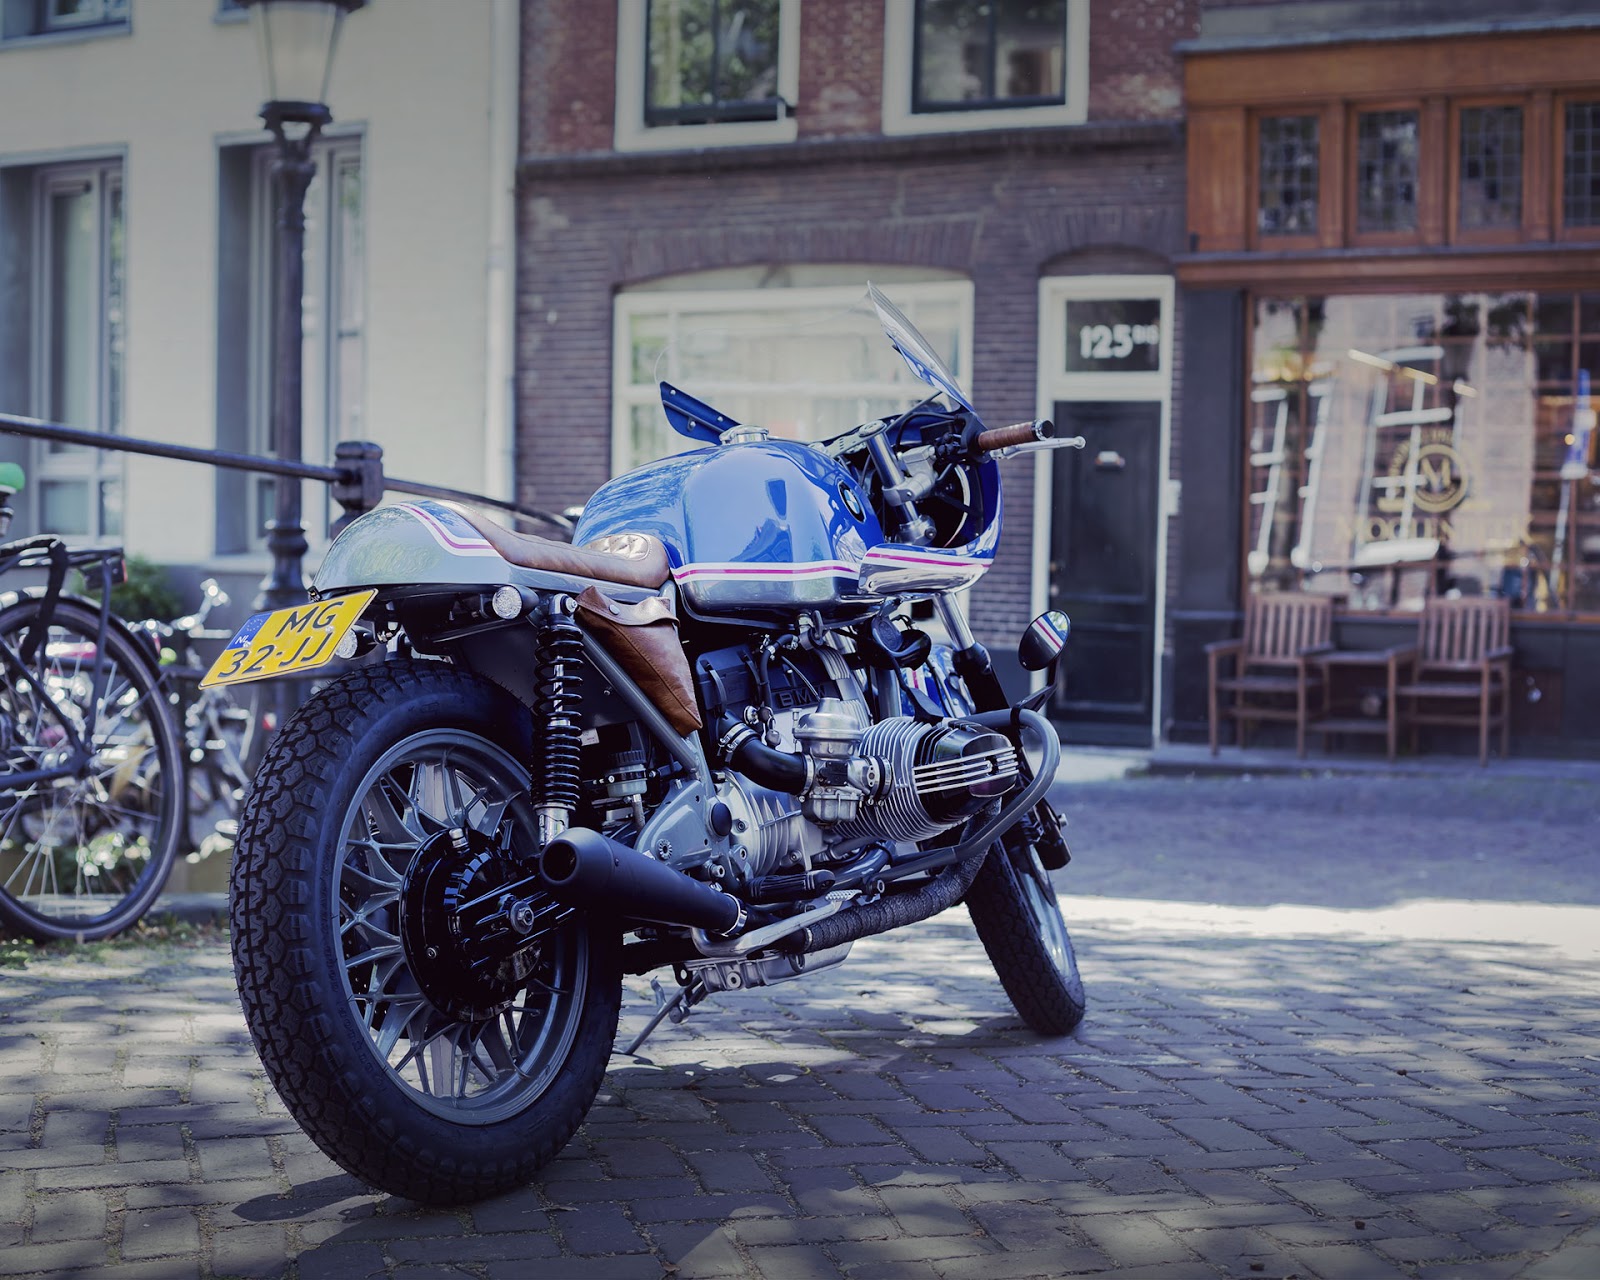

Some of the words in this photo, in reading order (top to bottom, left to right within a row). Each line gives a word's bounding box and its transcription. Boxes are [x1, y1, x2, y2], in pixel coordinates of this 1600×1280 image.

[275, 601, 344, 638] MG
[217, 632, 333, 678] 32-JJ
[235, 635, 250, 645] NL
